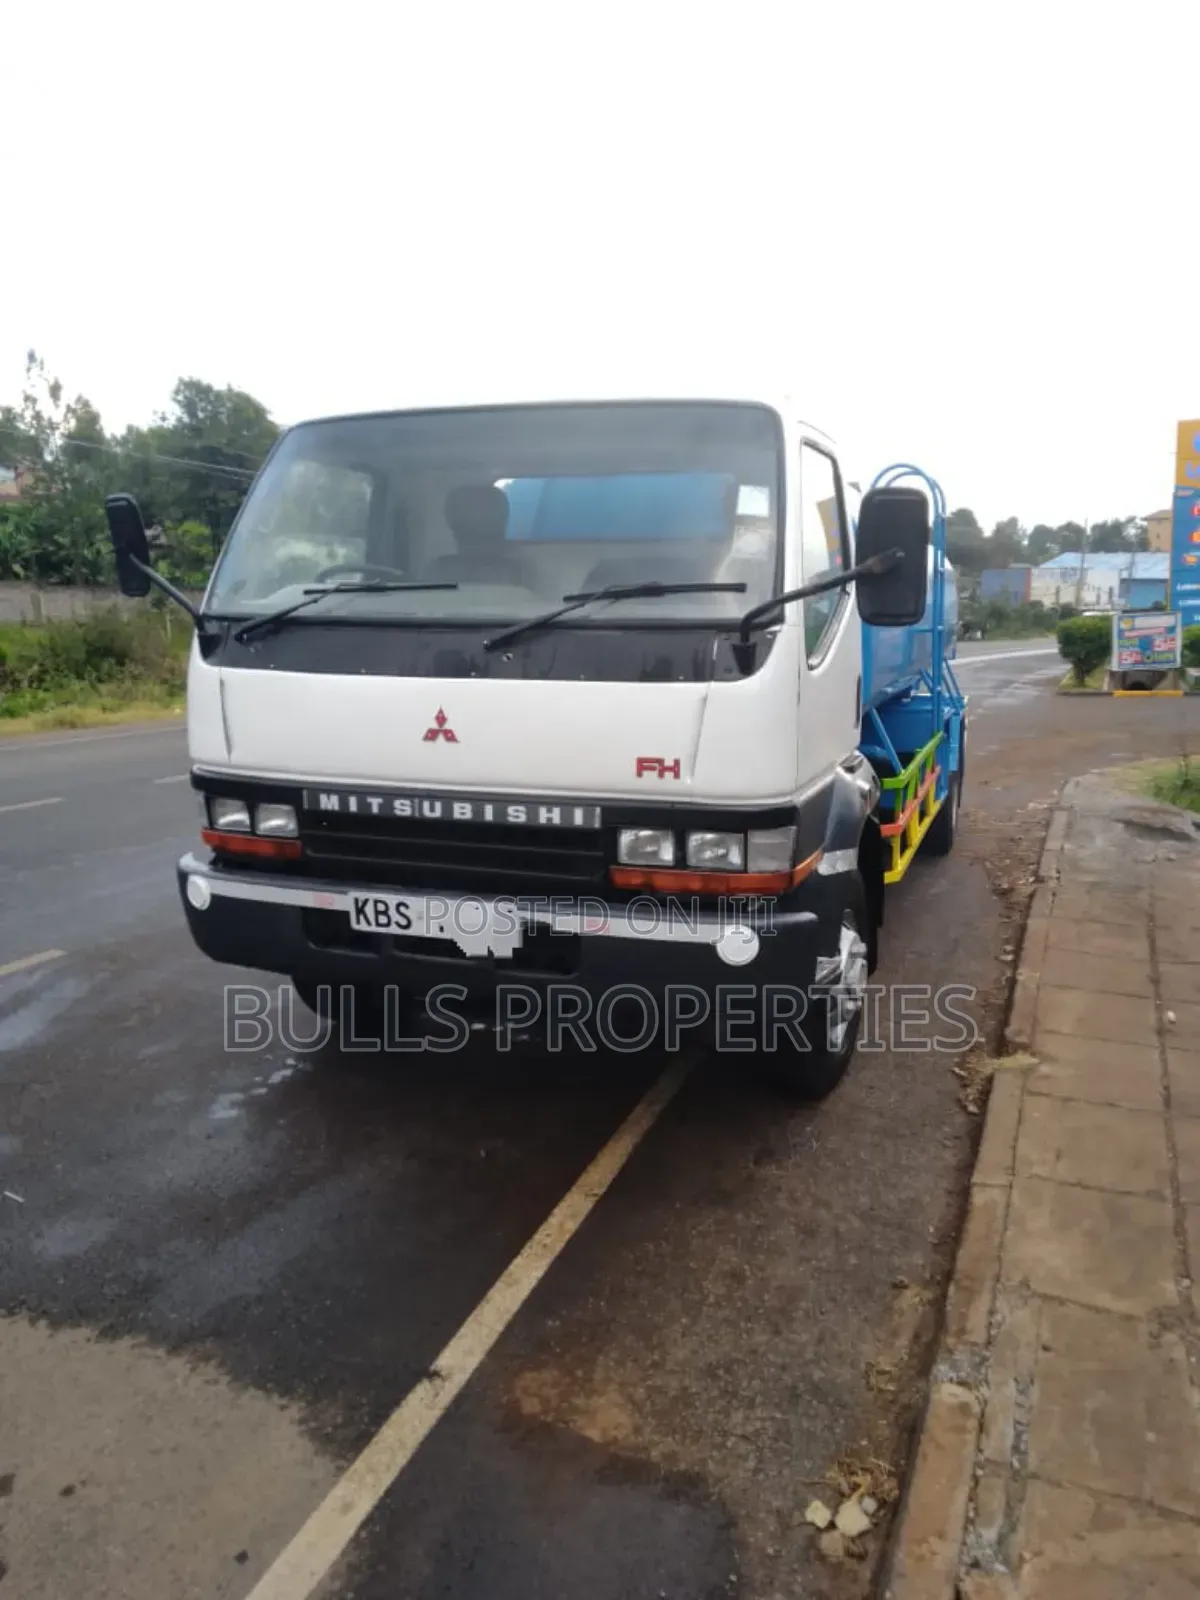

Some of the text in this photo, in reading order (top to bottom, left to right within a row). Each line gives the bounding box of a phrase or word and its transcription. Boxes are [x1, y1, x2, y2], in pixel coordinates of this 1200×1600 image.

[636, 757, 680, 779] FH
[319, 793, 583, 827] MITSUBISHI
[353, 897, 412, 930] KBS
